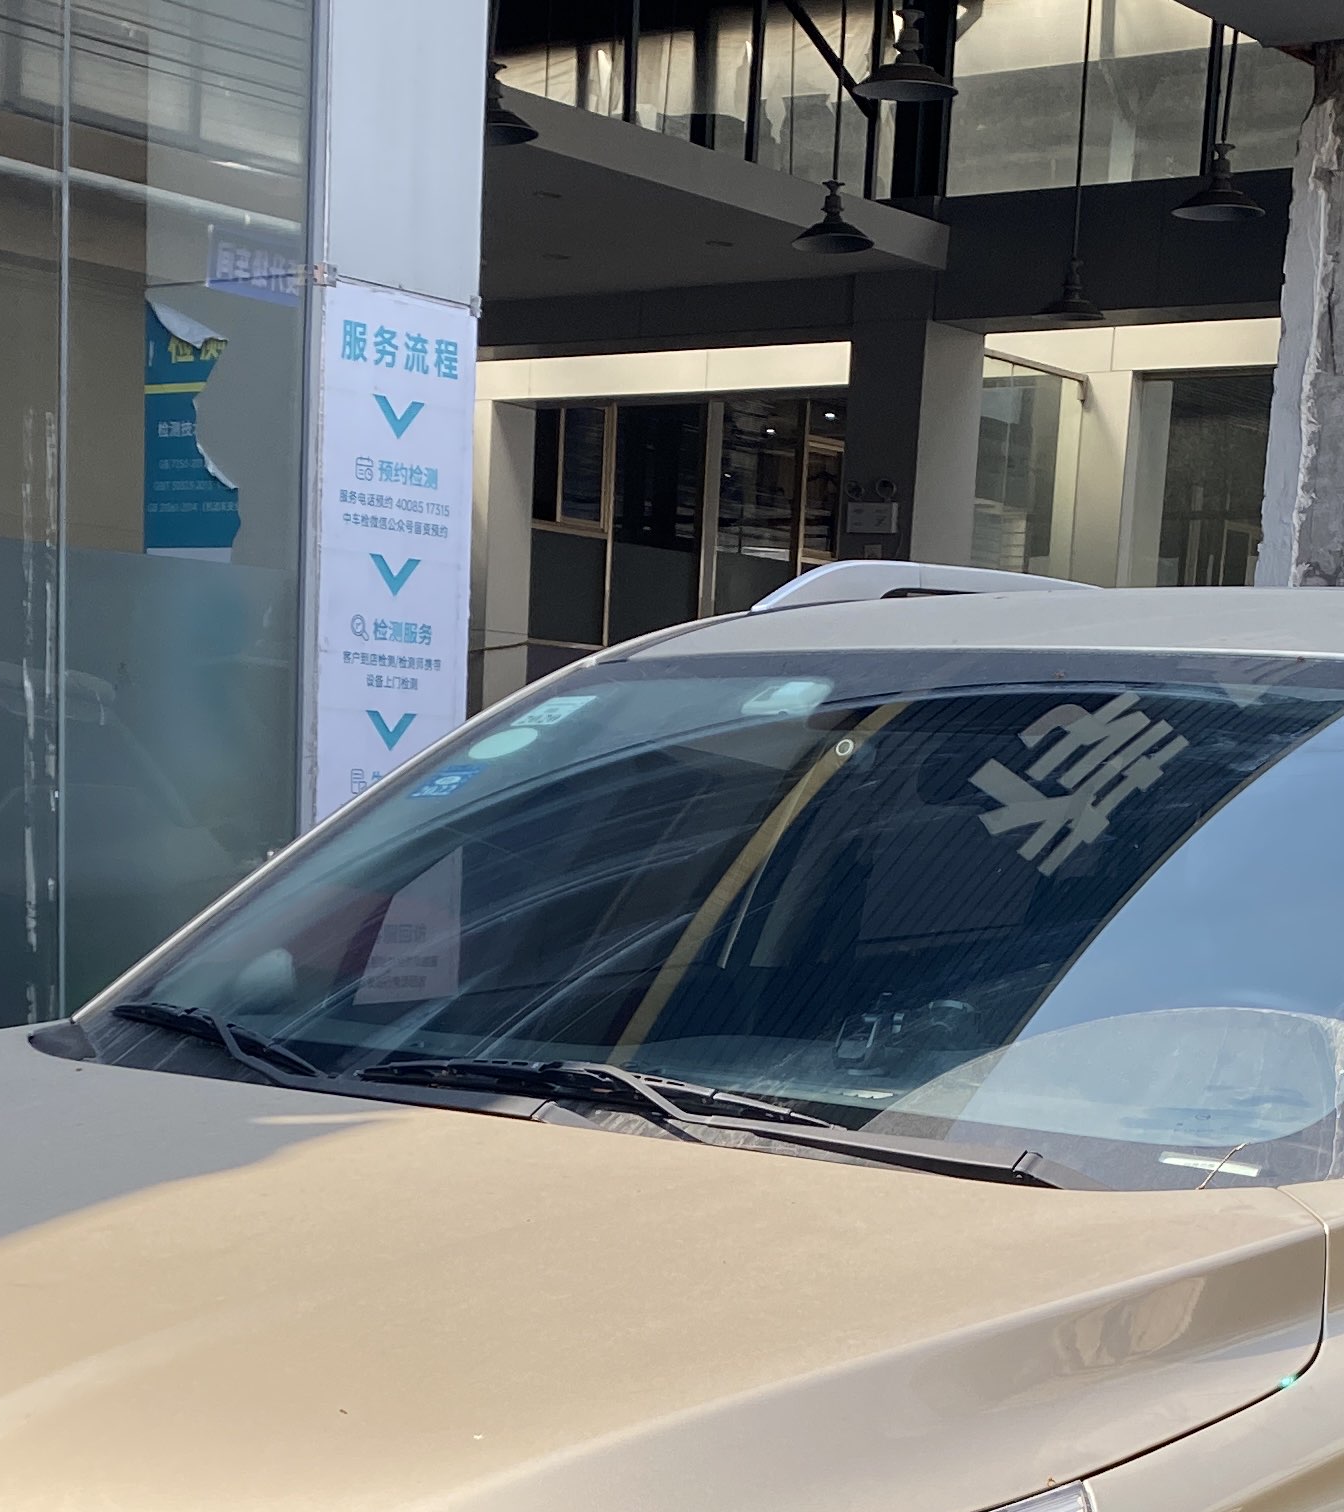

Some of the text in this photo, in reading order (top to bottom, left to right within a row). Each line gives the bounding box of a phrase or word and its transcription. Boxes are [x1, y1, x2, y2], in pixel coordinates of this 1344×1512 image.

[341, 319, 459, 380] 服务流程
[378, 459, 438, 490] 预约检测
[339, 489, 393, 510] 服务电话预约
[373, 618, 432, 646] 检测服务
[366, 673, 419, 691] 设备上门检测
